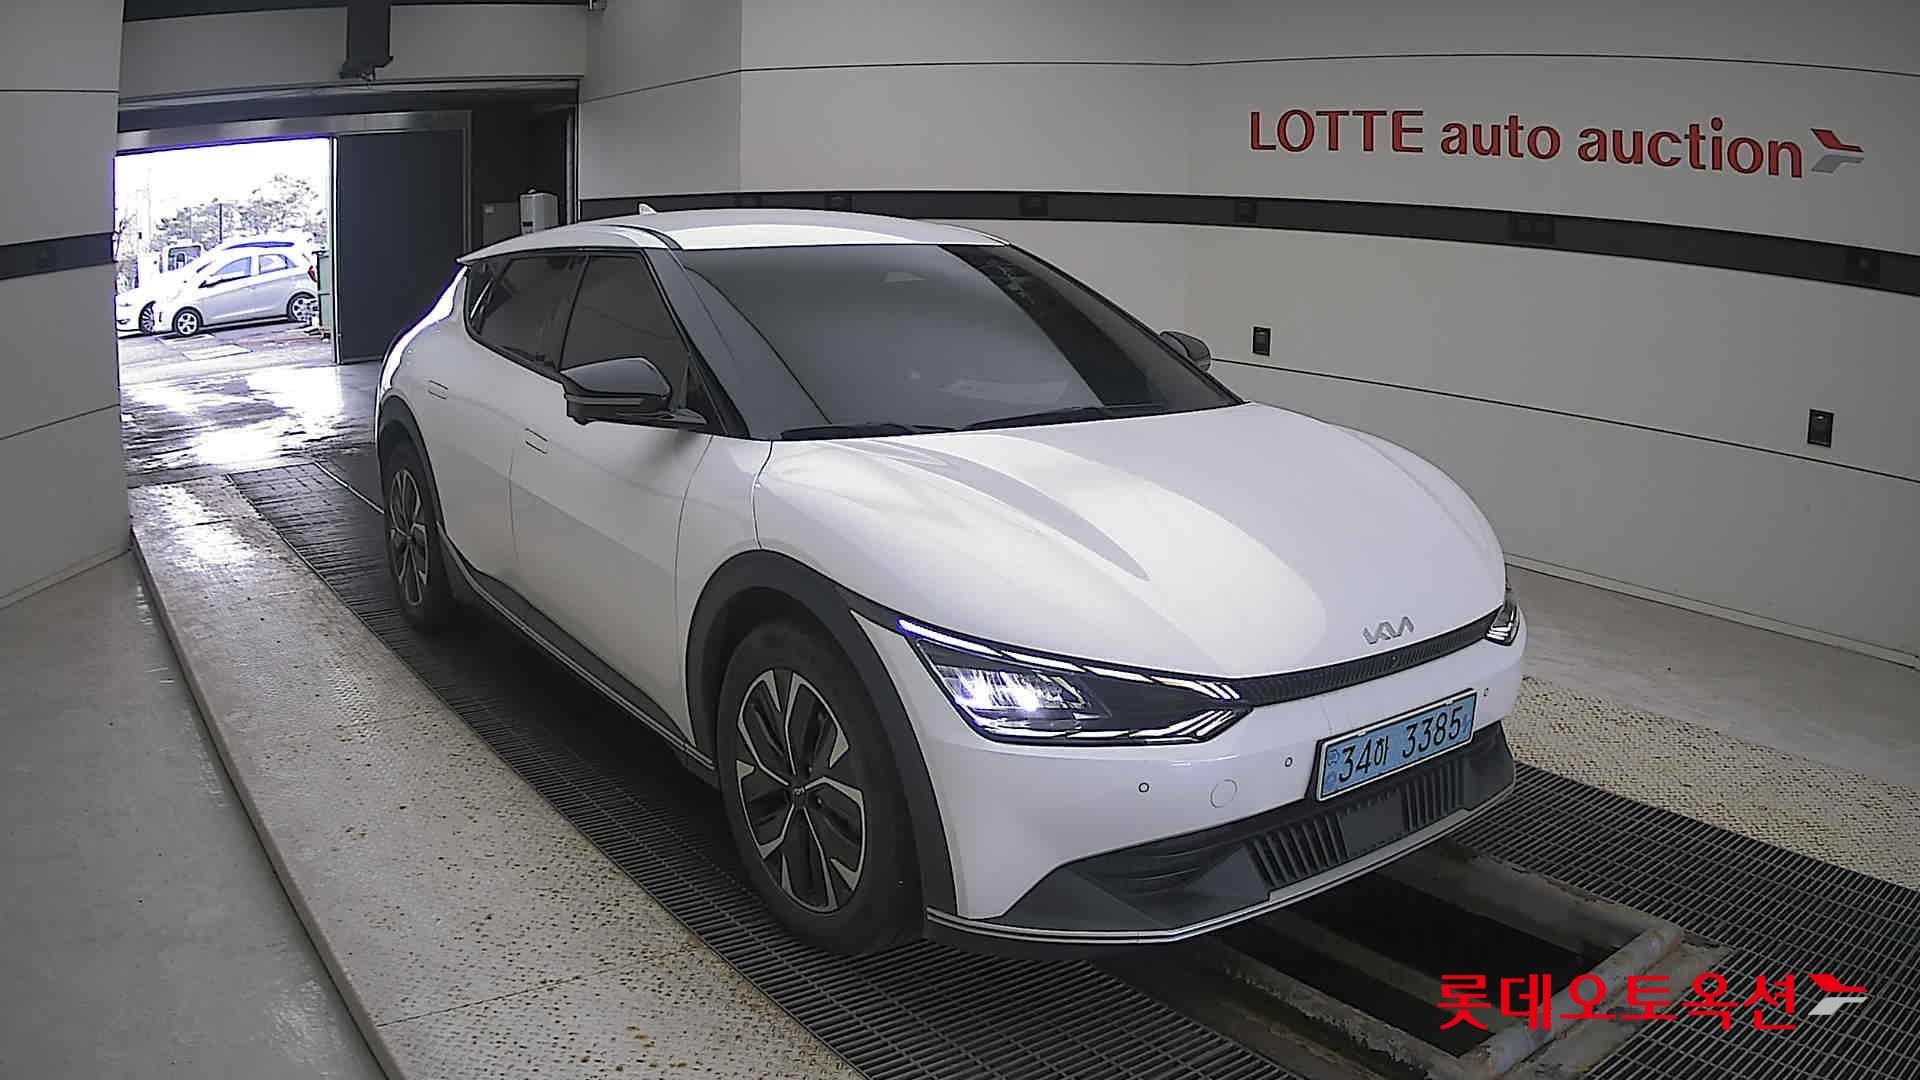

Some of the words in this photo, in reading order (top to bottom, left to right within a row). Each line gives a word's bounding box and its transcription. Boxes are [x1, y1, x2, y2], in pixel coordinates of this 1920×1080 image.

[1249, 109, 1424, 153] LOTTE
[1440, 115, 1561, 159] auto
[1576, 116, 1803, 178] auction
[1402, 706, 1463, 758] 3385
